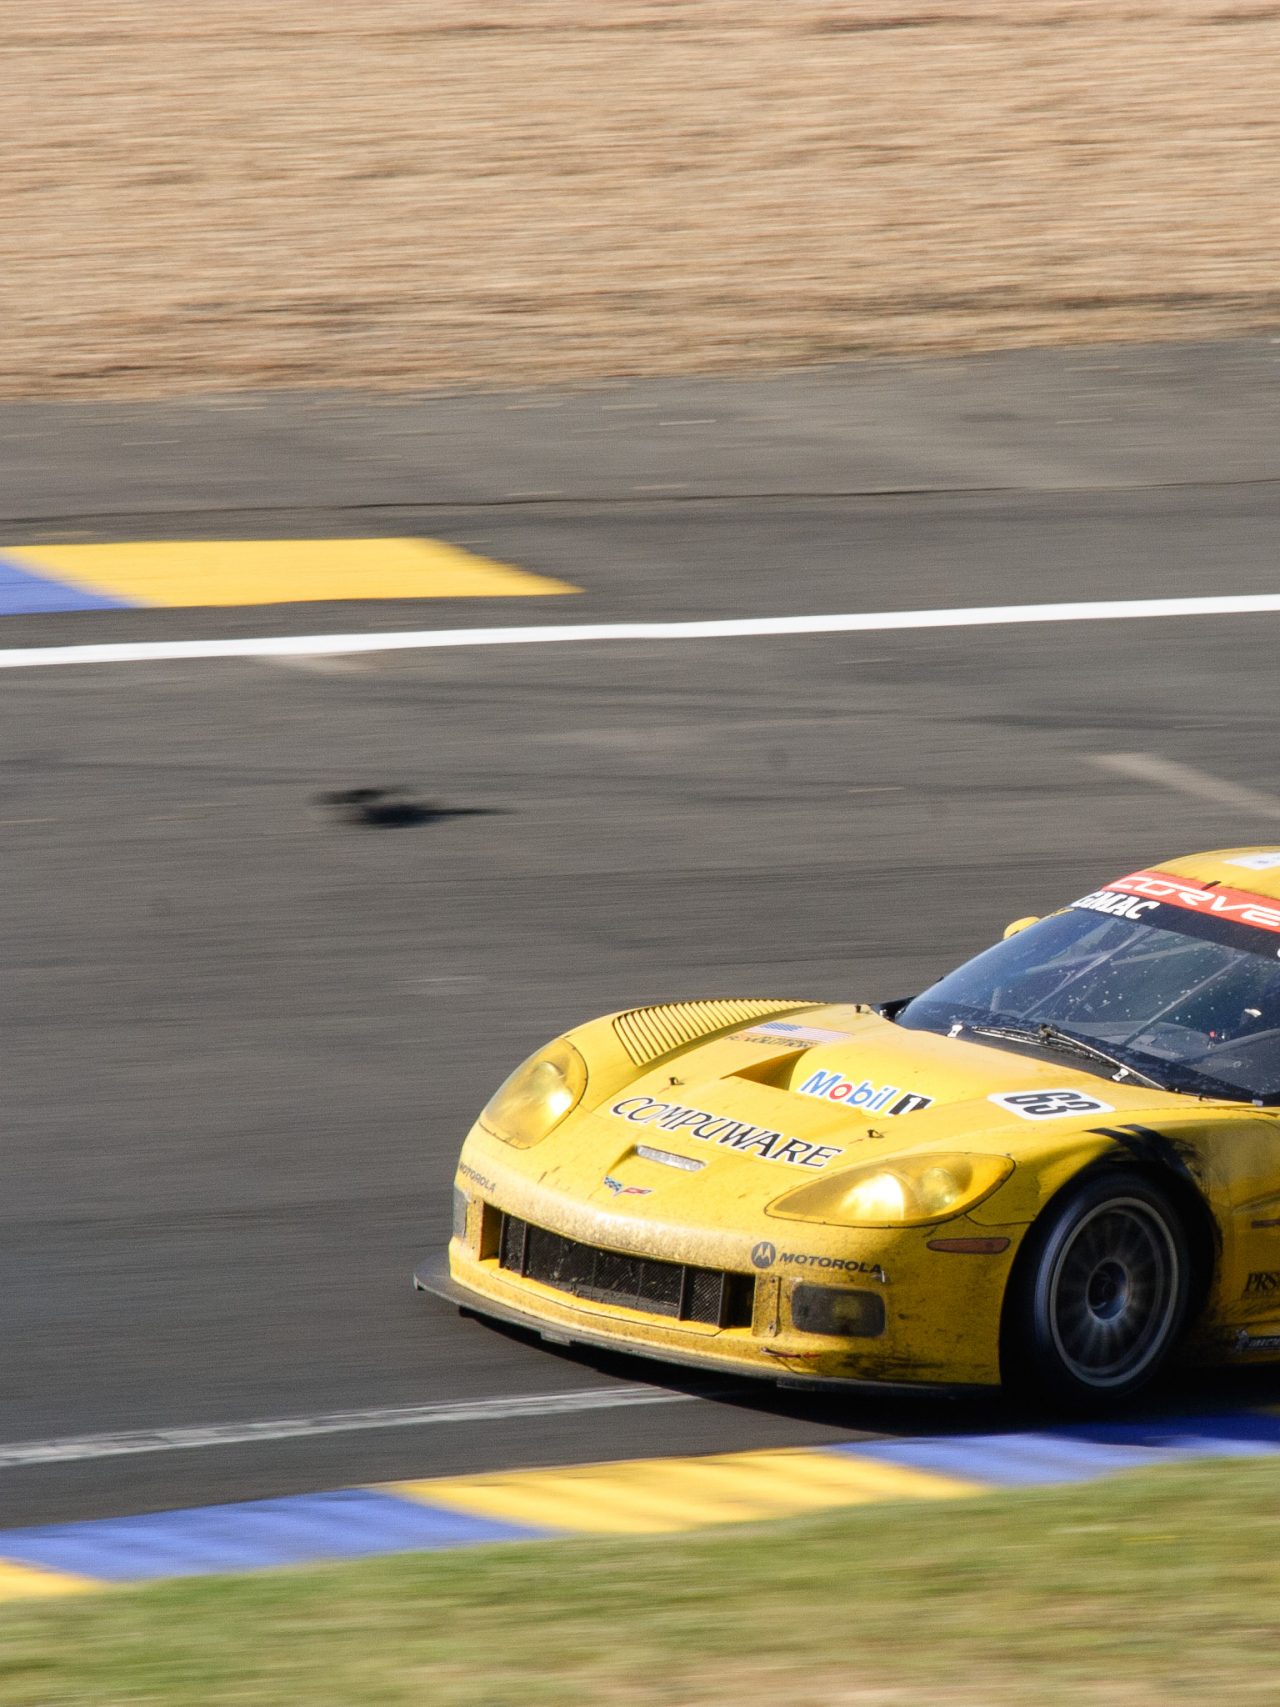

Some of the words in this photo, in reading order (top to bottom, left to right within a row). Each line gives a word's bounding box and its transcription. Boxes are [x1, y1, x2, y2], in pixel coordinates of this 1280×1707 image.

[1070, 890, 1161, 920] GMAC
[800, 1070, 898, 1111] Mobil
[1003, 1091, 1102, 1116] 63
[611, 1096, 843, 1168] COMPUWARE
[780, 1252, 884, 1274] MOTOROLA
